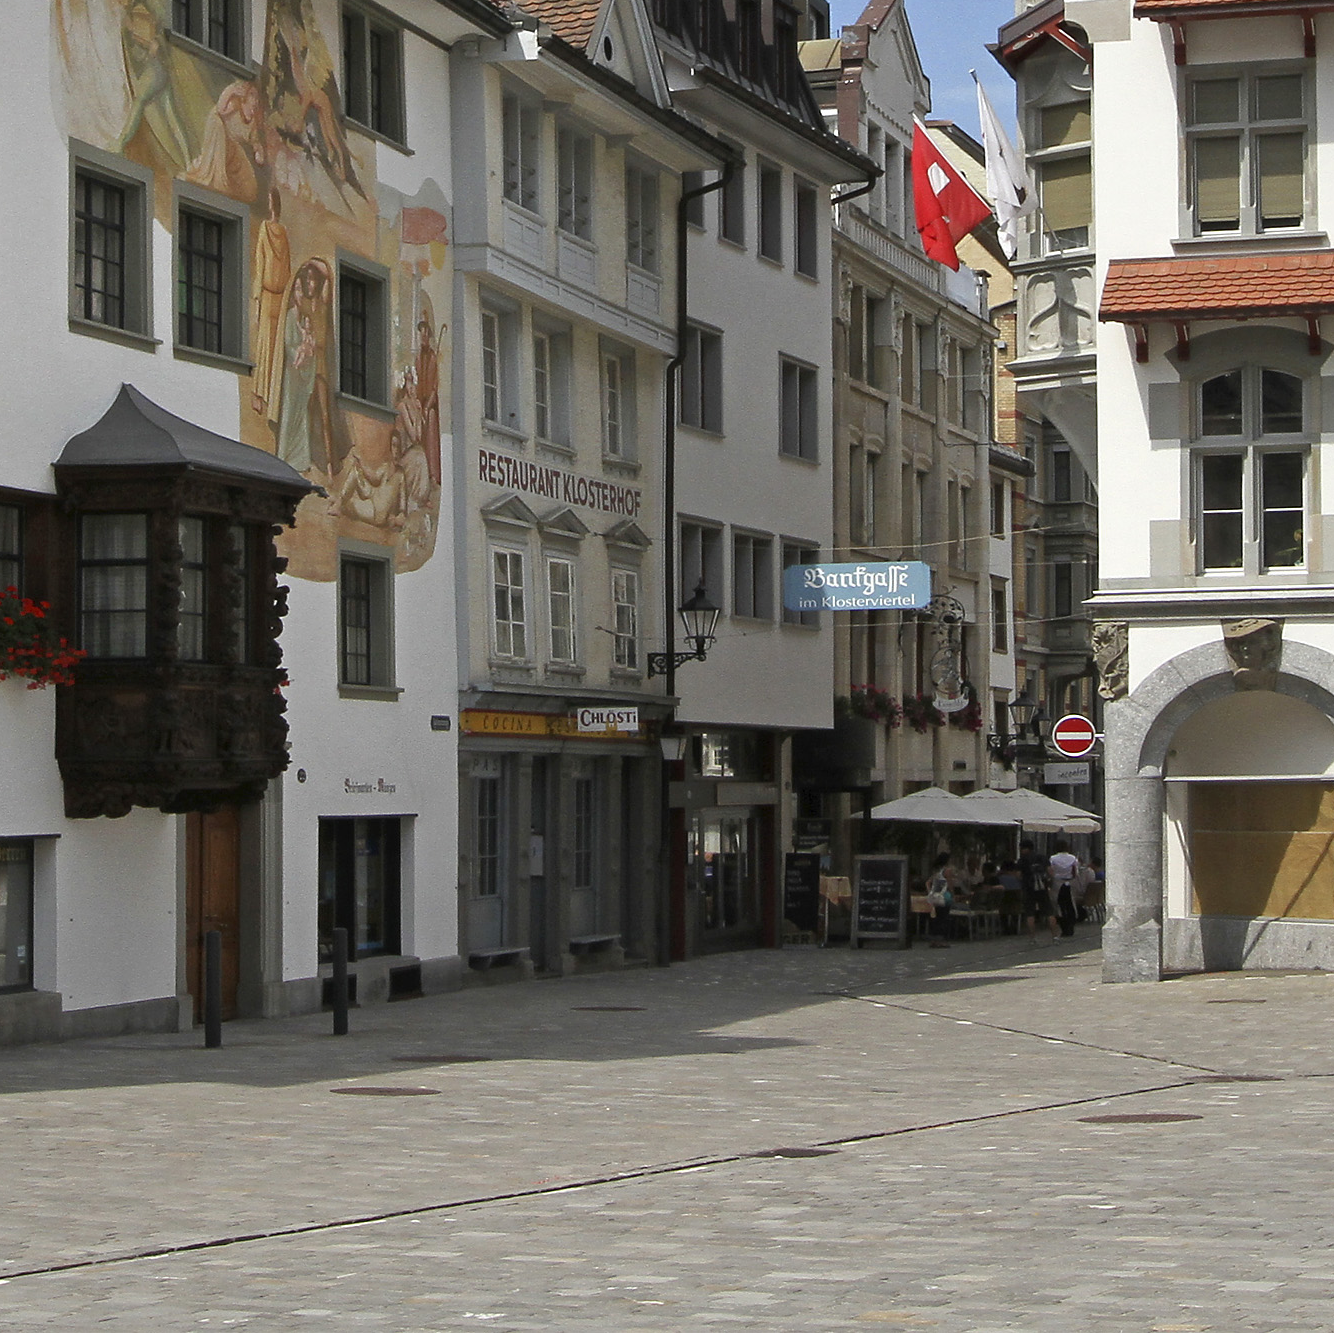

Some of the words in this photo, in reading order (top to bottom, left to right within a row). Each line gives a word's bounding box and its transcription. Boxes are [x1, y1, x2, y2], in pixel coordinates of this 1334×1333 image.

[478, 449, 561, 500] RESTAURANT
[562, 472, 642, 518] KLOSTERHOF
[799, 597, 817, 608] im
[822, 594, 915, 608] Klosterviertel
[483, 715, 533, 732] COCINA
